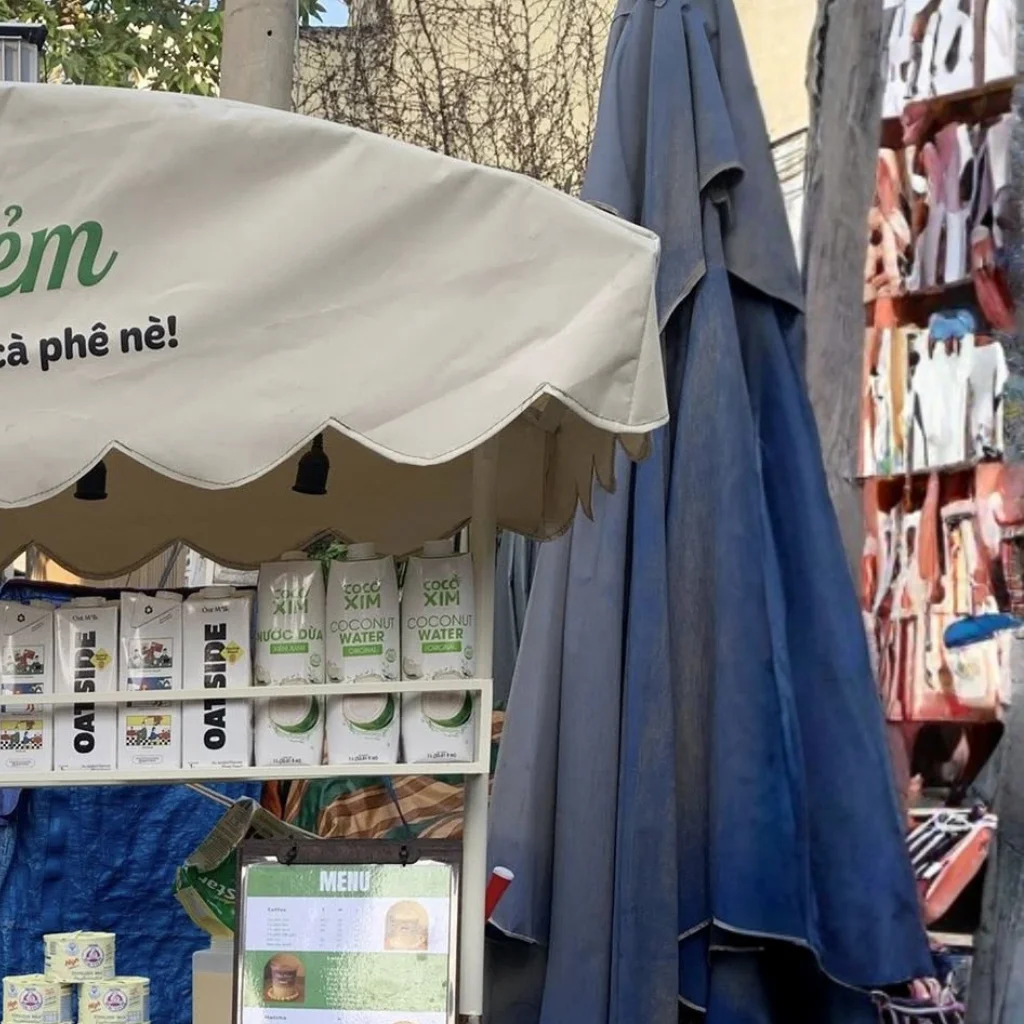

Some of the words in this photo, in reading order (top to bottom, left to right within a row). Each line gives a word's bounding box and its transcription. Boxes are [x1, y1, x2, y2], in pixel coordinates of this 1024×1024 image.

[39, 322, 110, 370] phê
[120, 315, 178, 354] nè!
[344, 594, 381, 610] XIM
[423, 591, 461, 607] XIM
[330, 617, 395, 632] COCONUT
[407, 614, 473, 629] COCONUT
[339, 631, 385, 644] WATER
[418, 628, 464, 641] WATER
[319, 870, 371, 892] MENU
